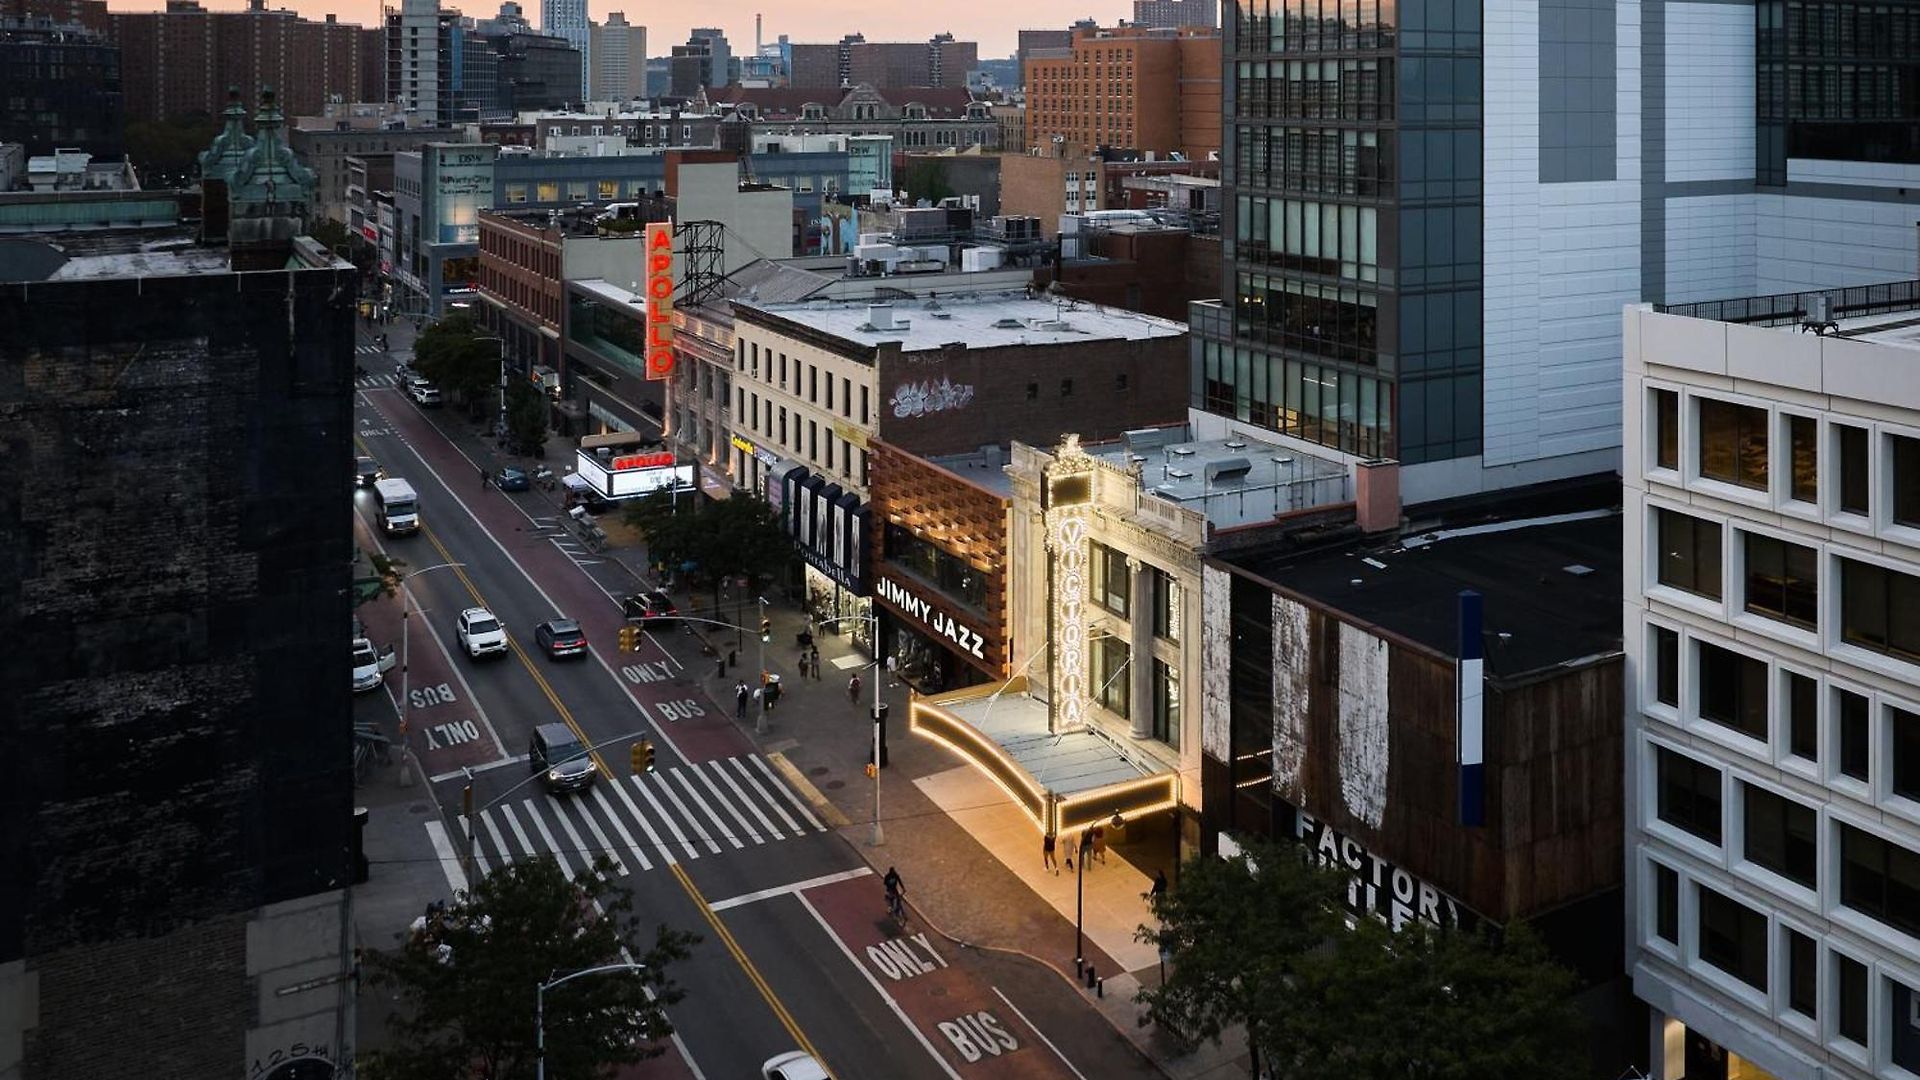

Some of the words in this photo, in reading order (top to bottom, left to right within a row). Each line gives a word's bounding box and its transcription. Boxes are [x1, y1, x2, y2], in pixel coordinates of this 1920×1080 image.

[459, 154, 481, 163] DSW
[652, 229, 674, 373] APOLLO
[876, 576, 932, 624] JIMMY
[933, 612, 985, 661] JAZZ
[1060, 519, 1086, 723] VICTORIA
[409, 683, 457, 708] BUS
[623, 661, 675, 684] ONLY
[656, 699, 706, 722] BUS
[424, 719, 480, 751] ONLY
[1296, 809, 1459, 930] FACTORY
[867, 933, 948, 980] ONLY
[938, 1011, 1018, 1062] BUS
